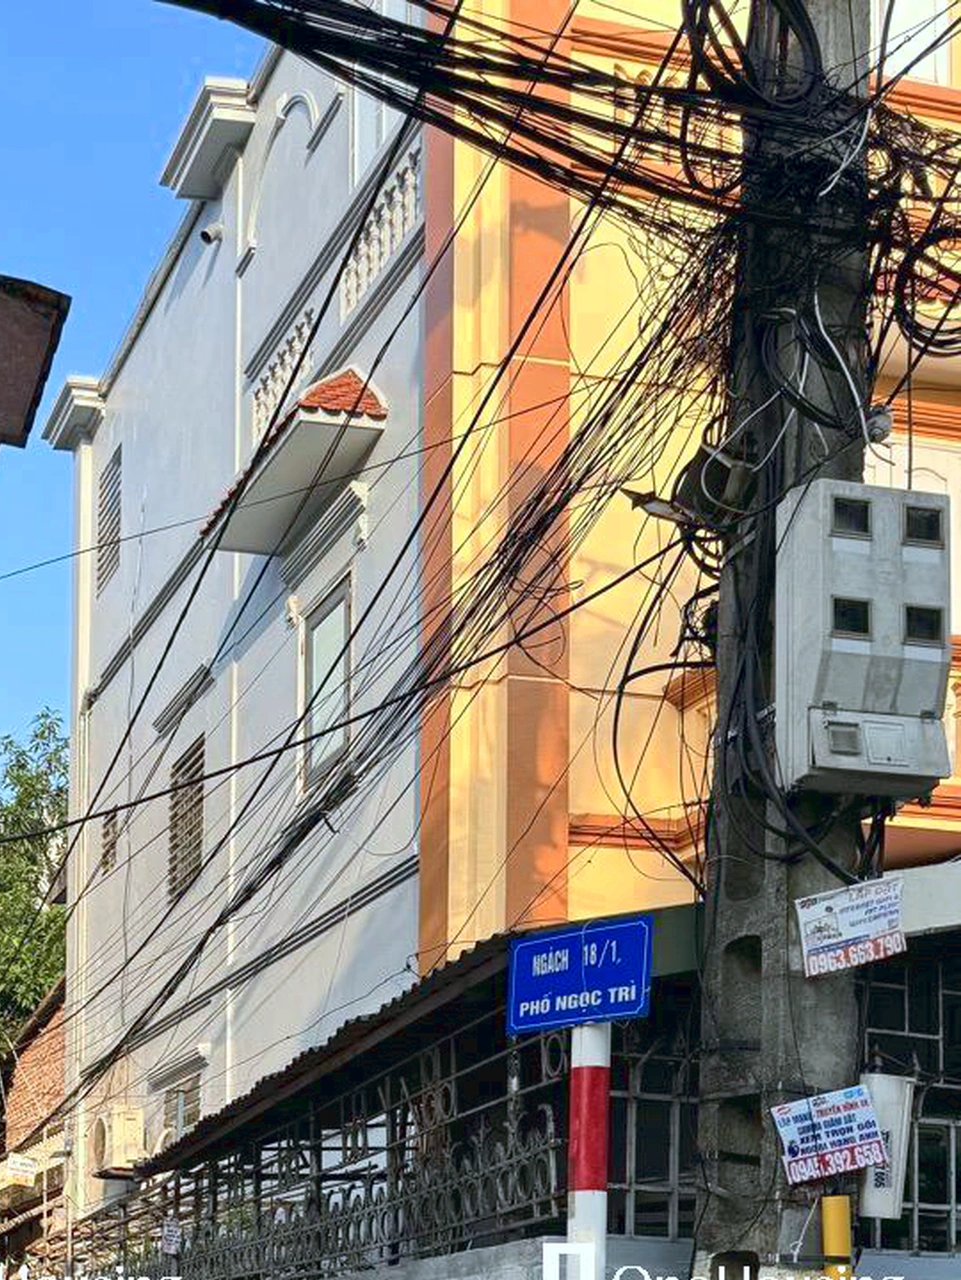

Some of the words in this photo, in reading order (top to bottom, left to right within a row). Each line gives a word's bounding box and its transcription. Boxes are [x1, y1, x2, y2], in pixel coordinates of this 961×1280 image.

[532, 946, 569, 977] NGÁCH
[520, 991, 552, 1018] PHỐ
[555, 989, 602, 1013] NGỌC
[608, 980, 637, 1004] TRÌ
